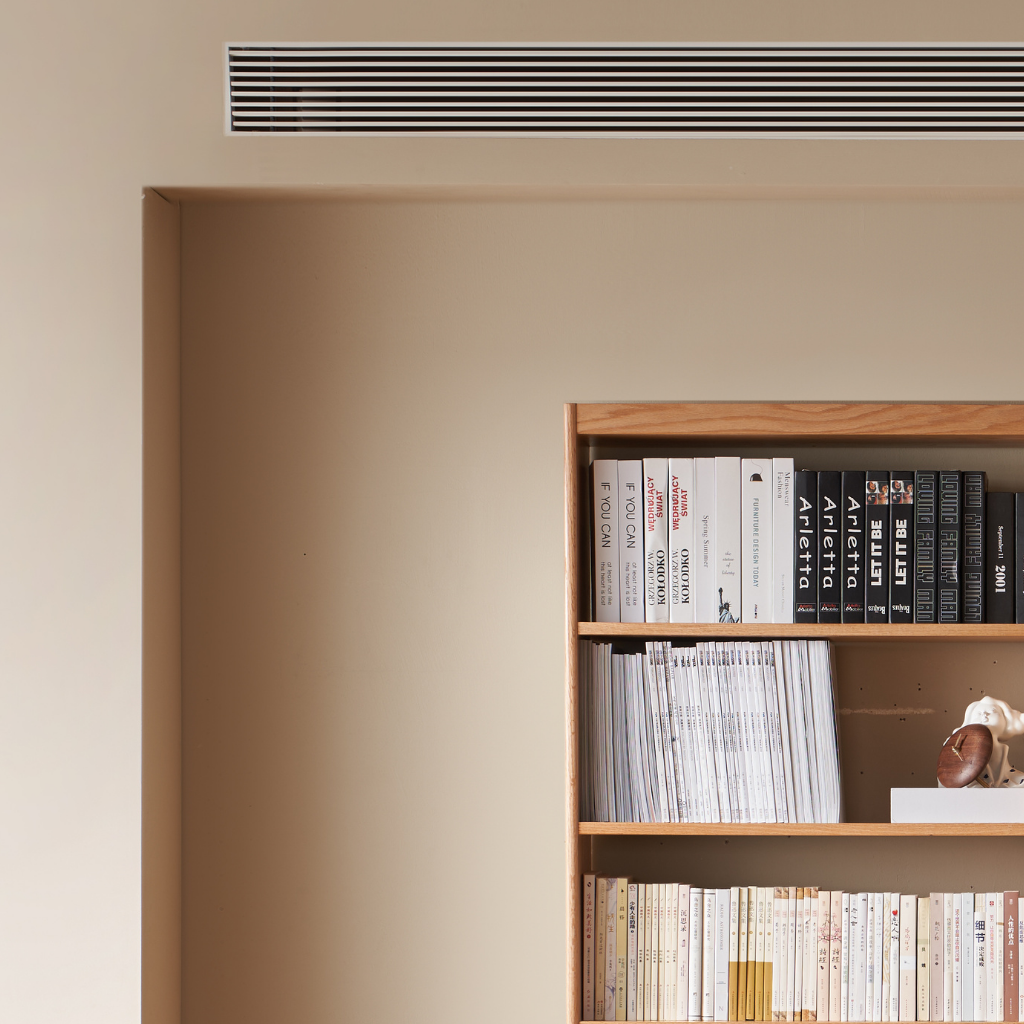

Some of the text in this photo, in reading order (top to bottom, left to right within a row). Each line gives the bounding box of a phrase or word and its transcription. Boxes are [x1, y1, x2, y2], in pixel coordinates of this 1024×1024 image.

[601, 482, 611, 548] IF YOU CAN
[626, 482, 636, 549] IF YOU CAN
[799, 496, 814, 589] Arletta
[823, 496, 838, 589] Arletta
[847, 496, 862, 589] Arletta
[917, 474, 934, 622] LOVING FAMILY MAN
[940, 474, 958, 622] LOVING FAMILY MAN
[964, 474, 982, 622] LOVING FAMILY MAN
[656, 549, 666, 605] KOŁODKO
[681, 548, 690, 604] KOŁODKO
[870, 520, 882, 586] LET IT BE
[896, 519, 907, 586] LET IT BE
[995, 564, 1006, 593] 2001
[974, 920, 986, 943] 细节
